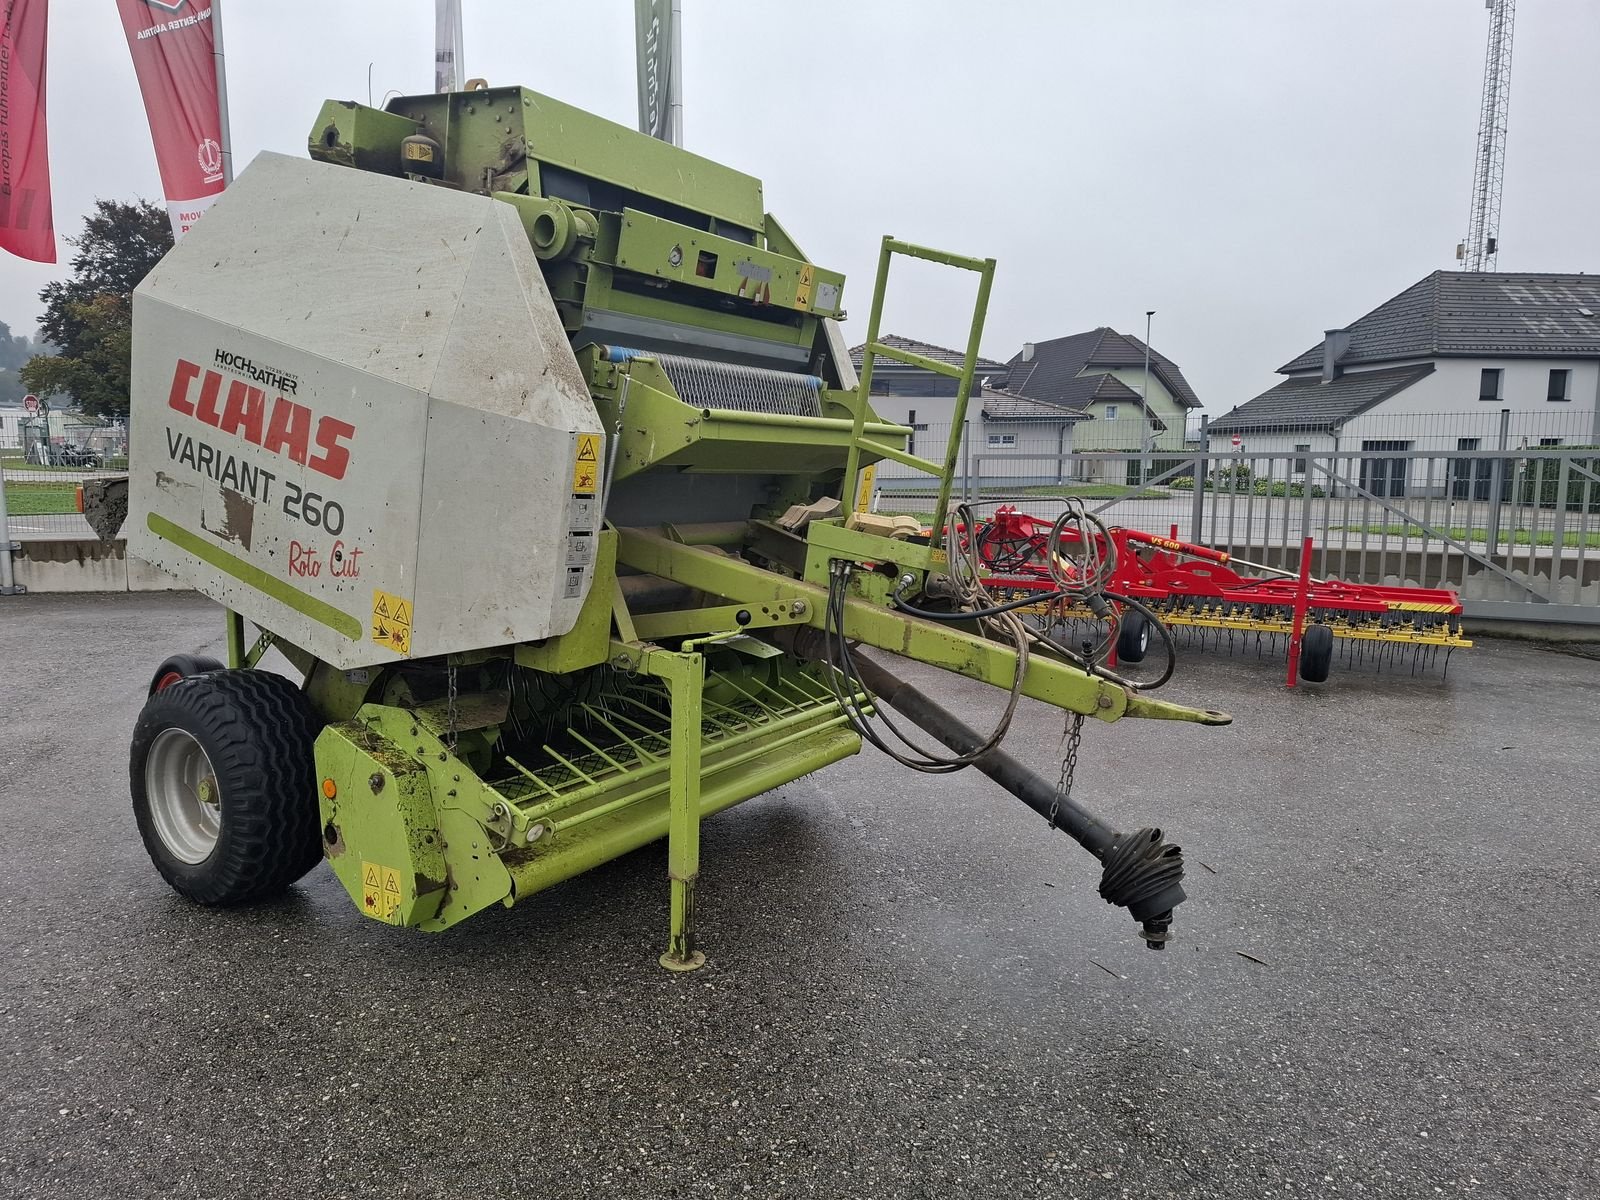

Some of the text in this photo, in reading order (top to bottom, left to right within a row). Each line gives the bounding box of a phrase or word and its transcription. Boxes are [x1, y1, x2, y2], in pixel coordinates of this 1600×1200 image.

[0, 131, 12, 197] Europas
[215, 349, 297, 395] HOCHRATHER
[26, 400, 37, 408] STOP
[169, 359, 355, 480] CLAAS
[165, 427, 345, 536] VARIANT 260
[289, 540, 364, 578] Roto Cut
[1151, 537, 1162, 546] VS
[1163, 540, 1180, 550] 600
